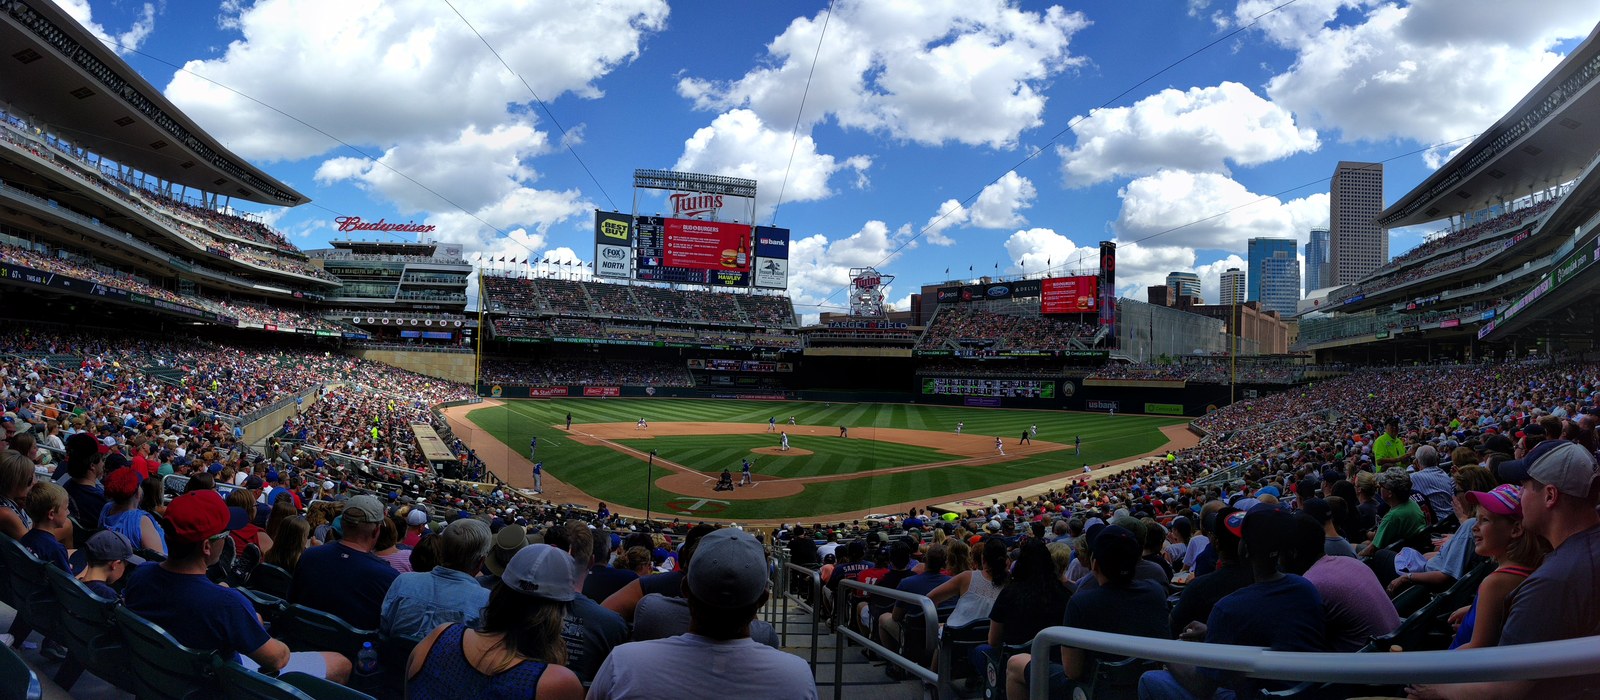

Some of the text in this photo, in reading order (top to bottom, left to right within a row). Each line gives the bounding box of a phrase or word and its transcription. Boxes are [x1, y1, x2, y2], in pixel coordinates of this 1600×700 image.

[669, 191, 724, 214] Twins
[334, 216, 436, 232] Budweiser
[604, 221, 628, 231] BEST
[605, 227, 625, 237] BUY
[607, 248, 621, 256] FOX
[602, 261, 625, 270] NORTH
[853, 275, 881, 290] Twins
[944, 291, 958, 299] pepsi
[991, 287, 1004, 295] Ford
[828, 321, 908, 330] TARGET FIELD
[842, 563, 869, 573] SANTANA
